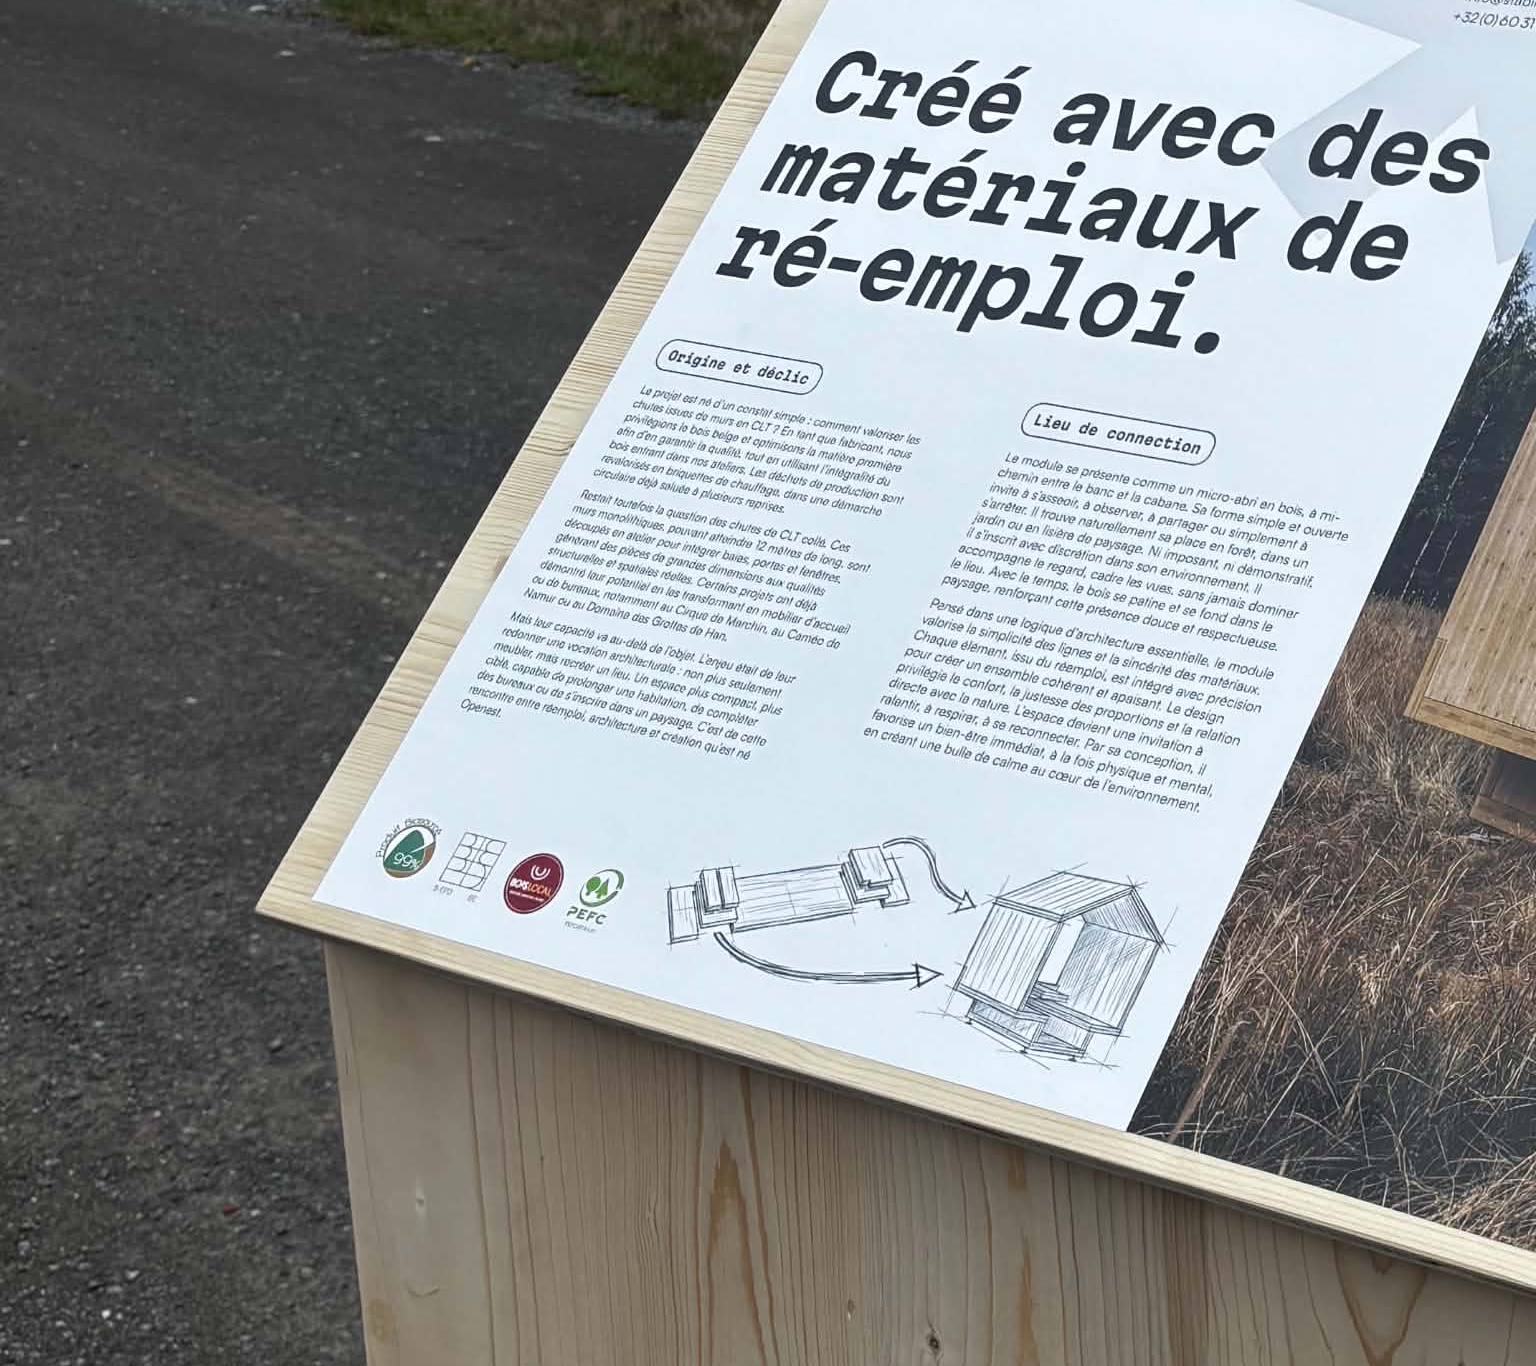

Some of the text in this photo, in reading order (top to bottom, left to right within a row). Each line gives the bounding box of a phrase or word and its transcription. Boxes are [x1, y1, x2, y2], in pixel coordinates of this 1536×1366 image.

[815, 50, 1490, 194] Créé avec des
[759, 143, 1409, 281] matériaux de
[715, 218, 1220, 355] ré-emploi.
[668, 349, 809, 385] Origine et déclic
[1033, 413, 1201, 455] Lieu de connection
[996, 467, 1040, 484] chemin
[1040, 476, 1071, 491] entre
[1071, 479, 1084, 493] le
[1084, 482, 1116, 499] banc
[1115, 490, 1130, 500] et
[1129, 490, 1142, 504] la
[1190, 501, 1208, 516] Sa
[1209, 505, 1246, 523] forme
[1245, 513, 1287, 531] simple
[1287, 522, 1302, 533] et
[1302, 525, 1350, 542] ouverte
[1004, 451, 1020, 464] Le
[1020, 456, 1064, 473] module
[1064, 464, 1080, 476] se
[1078, 467, 1131, 485] présente
[1131, 476, 1177, 494] comme
[1177, 485, 1195, 497] un
[1195, 488, 1260, 508] micro-abri
[1258, 500, 1276, 512] en
[1318, 511, 1341, 523] mi-
[965, 526, 976, 539] il
[1017, 539, 1047, 553] avec
[1046, 543, 1104, 564] discrétion
[1104, 554, 1135, 570] dans
[1134, 562, 1159, 575] son
[1253, 582, 1264, 596] Il
[970, 511, 1006, 528] jardin
[1006, 520, 1024, 532] ou
[1023, 523, 1040, 534] en
[1040, 523, 1076, 542] lisière
[1075, 531, 1093, 545] de
[1146, 544, 1164, 558] Ni
[1222, 561, 1235, 572] ni
[1029, 505, 1041, 518] Il
[1039, 507, 1077, 525] trouve
[1076, 516, 1158, 540] naturellement
[1156, 532, 1173, 544] sa
[1171, 534, 1207, 550] place
[1208, 541, 1225, 554] en
[1259, 549, 1291, 566] dans
[1291, 558, 1310, 570] un
[928, 596, 965, 615] Pensé
[965, 605, 995, 622] dans
[995, 614, 1019, 627] une
[1019, 616, 1064, 636] logique
[1213, 656, 1226, 670] le
[1226, 662, 1275, 681] module
[993, 585, 1055, 606] renforçant
[1053, 597, 1085, 612] cette
[1084, 604, 1141, 624] présence
[1141, 613, 1181, 632] douce
[1180, 623, 1196, 635] et
[912, 628, 959, 649] Chaque
[1010, 648, 1035, 666] issu
[1034, 655, 1053, 669] du
[1110, 673, 1131, 686] est
[1130, 674, 1174, 696] intégré
[1174, 687, 1205, 702] avec
[1204, 694, 1263, 714] précision
[887, 676, 929, 696] directe
[928, 687, 958, 702] avec
[957, 691, 971, 705] la
[1065, 715, 1112, 736] devient
[1111, 728, 1137, 742] une
[1137, 731, 1193, 755] invitation
[862, 726, 880, 739] en
[879, 730, 919, 748] créant
[918, 739, 943, 753] une
[942, 741, 973, 760] bulle
[973, 749, 991, 764] de
[991, 756, 1029, 773] calme
[1029, 765, 1047, 777] au
[1082, 775, 1101, 790] de
[567, 906, 607, 925] PEFC
